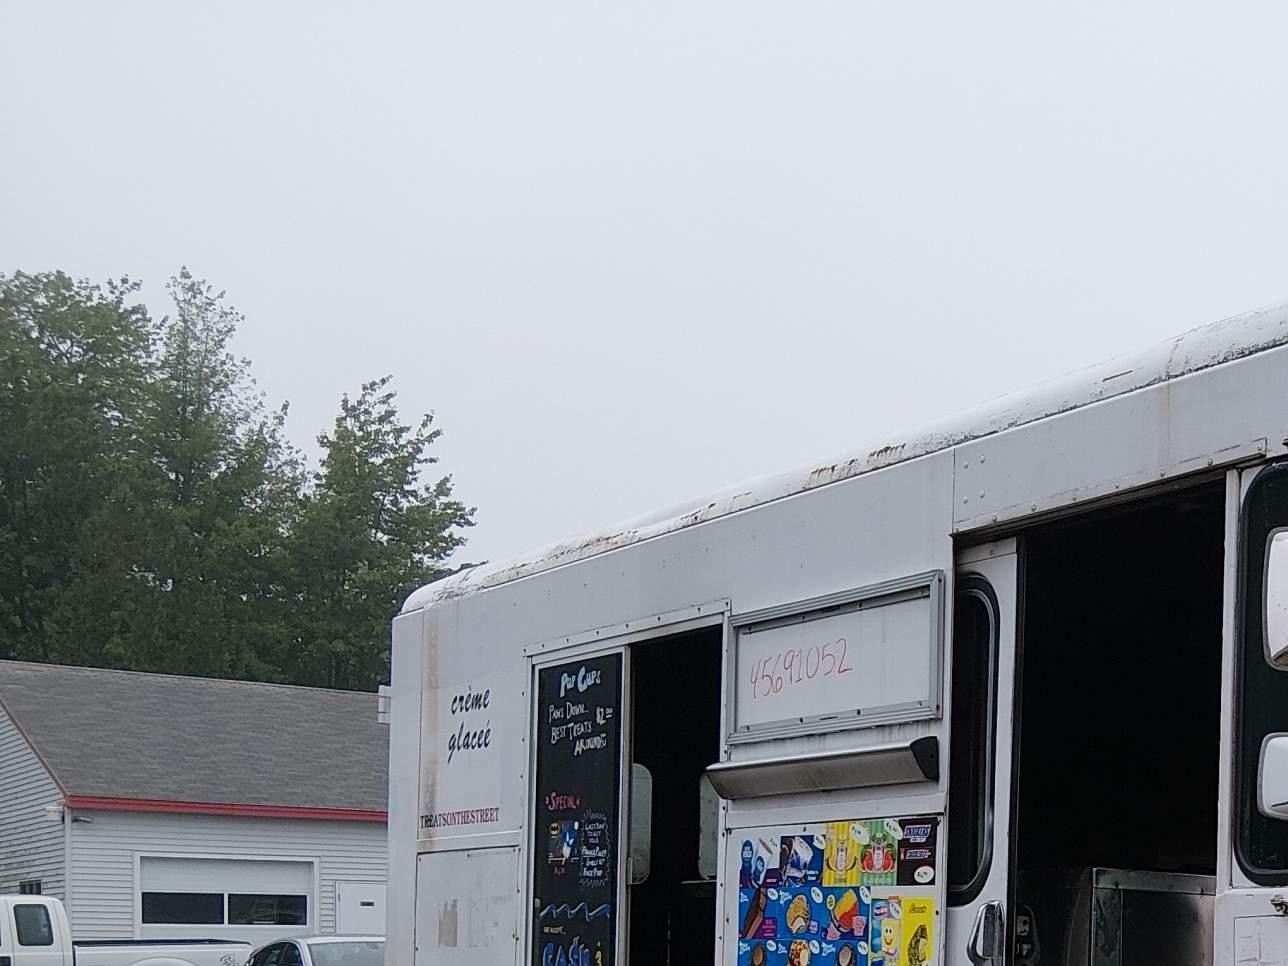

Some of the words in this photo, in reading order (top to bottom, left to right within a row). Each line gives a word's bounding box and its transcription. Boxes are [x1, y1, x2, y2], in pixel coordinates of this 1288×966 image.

[578, 666, 601, 693] CUPS
[750, 638, 853, 699] 45691052
[451, 686, 490, 715] crème
[551, 726, 567, 744] BEST
[567, 721, 592, 740] TREATS
[420, 807, 500, 829] TREATSONTHESTREET
